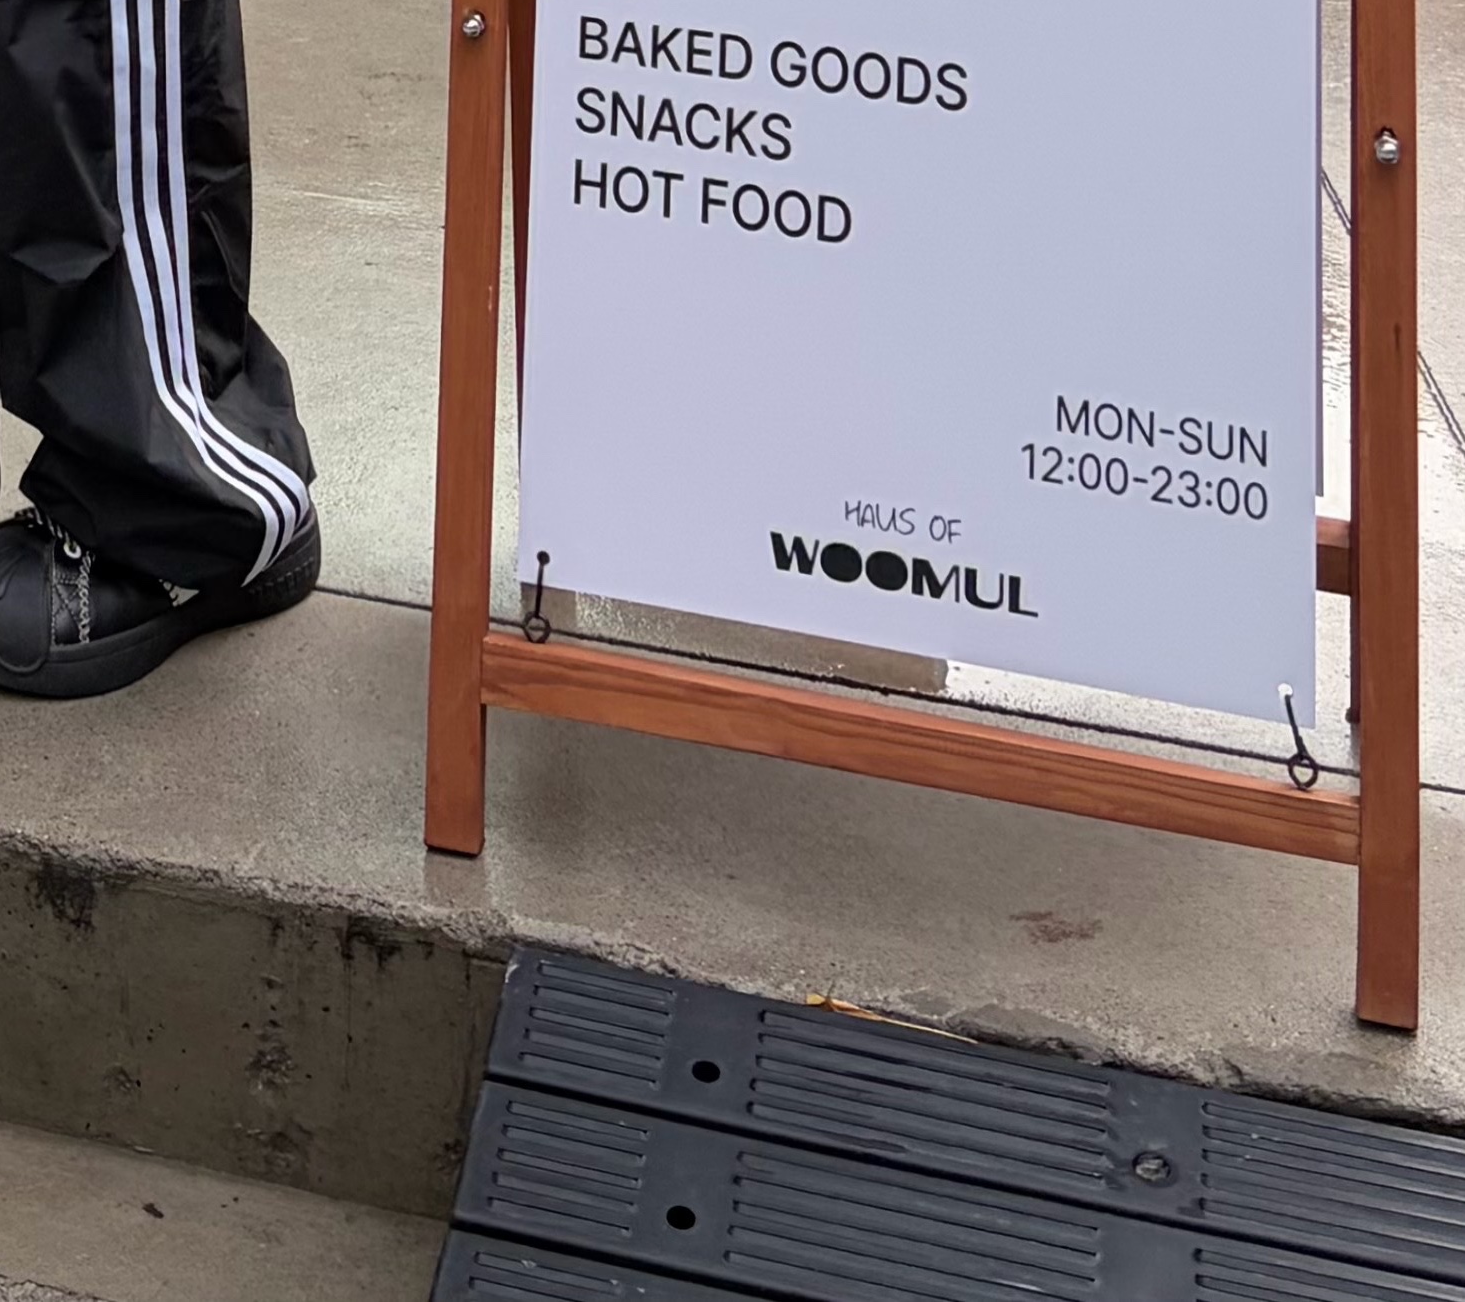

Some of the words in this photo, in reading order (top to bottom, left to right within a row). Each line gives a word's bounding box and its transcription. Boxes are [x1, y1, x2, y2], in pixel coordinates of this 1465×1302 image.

[578, 15, 753, 81] BAKED
[769, 40, 969, 112] GOODS
[574, 86, 793, 161] SNACKS
[573, 158, 685, 219] HOT
[699, 177, 853, 244] FOOD
[1055, 395, 1269, 468] MON-SUN
[1020, 442, 1269, 521] 12:00-23:00
[844, 499, 917, 536] HAUS
[928, 514, 962, 544] OF
[769, 530, 1039, 618] WOOMUL
